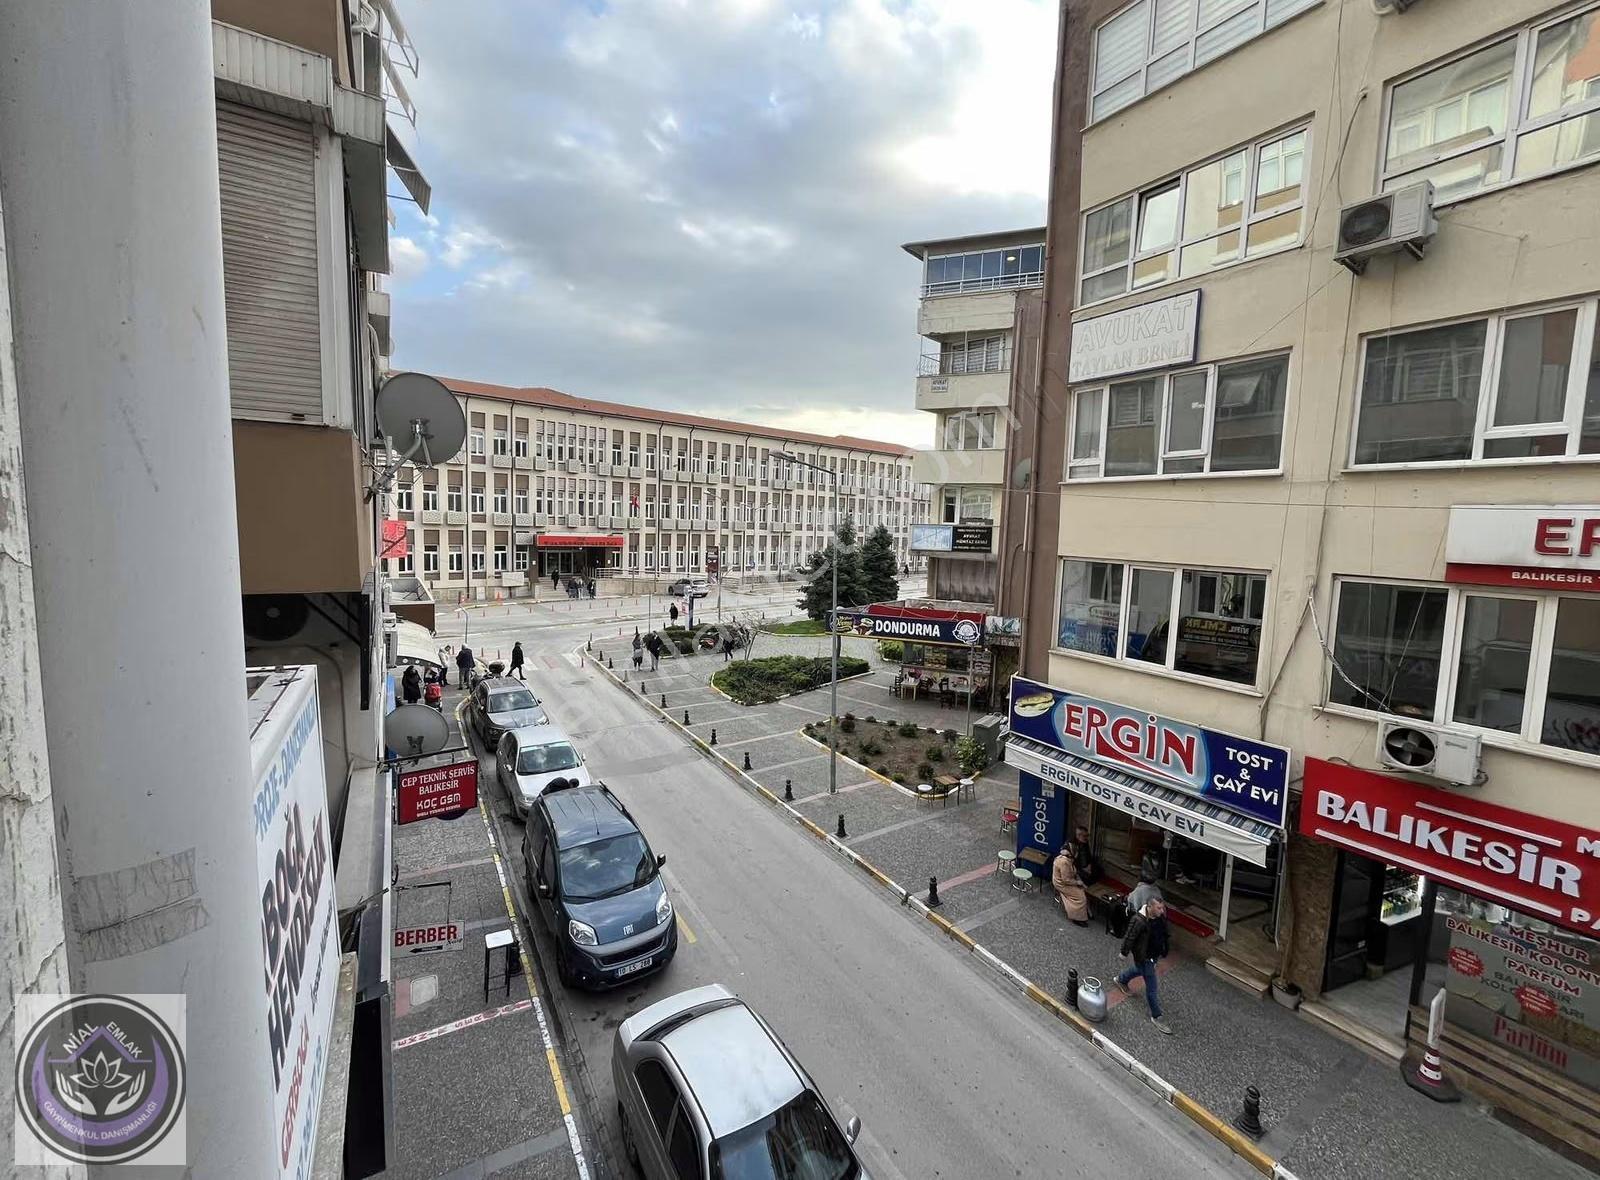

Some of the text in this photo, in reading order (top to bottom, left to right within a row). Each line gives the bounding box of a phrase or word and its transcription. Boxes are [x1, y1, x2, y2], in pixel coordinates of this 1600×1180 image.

[1076, 298, 1193, 354] AVUKAT
[1072, 350, 1132, 376] TAYLAN
[1511, 571, 1593, 584] BALIKESİR
[875, 619, 941, 637] DONDURMA
[1063, 703, 1196, 784] ERGİN
[1225, 747, 1274, 771] TOST
[401, 764, 475, 788] CEP TEKNİK SERVİS
[419, 778, 459, 796] BALIKESİR
[1239, 768, 1251, 781] &
[416, 793, 461, 811] KOÇ GSM
[1040, 763, 1206, 838] ERGİN TOST & ÇAY EVİ
[1212, 774, 1279, 806] ÇAY EVİ
[1032, 796, 1050, 845] pepsi
[1316, 789, 1582, 898] BALIKESİR
[394, 925, 458, 948] BERBER
[1446, 916, 1525, 957] BALIKESİR
[1508, 925, 1590, 964] MEŞHUR
